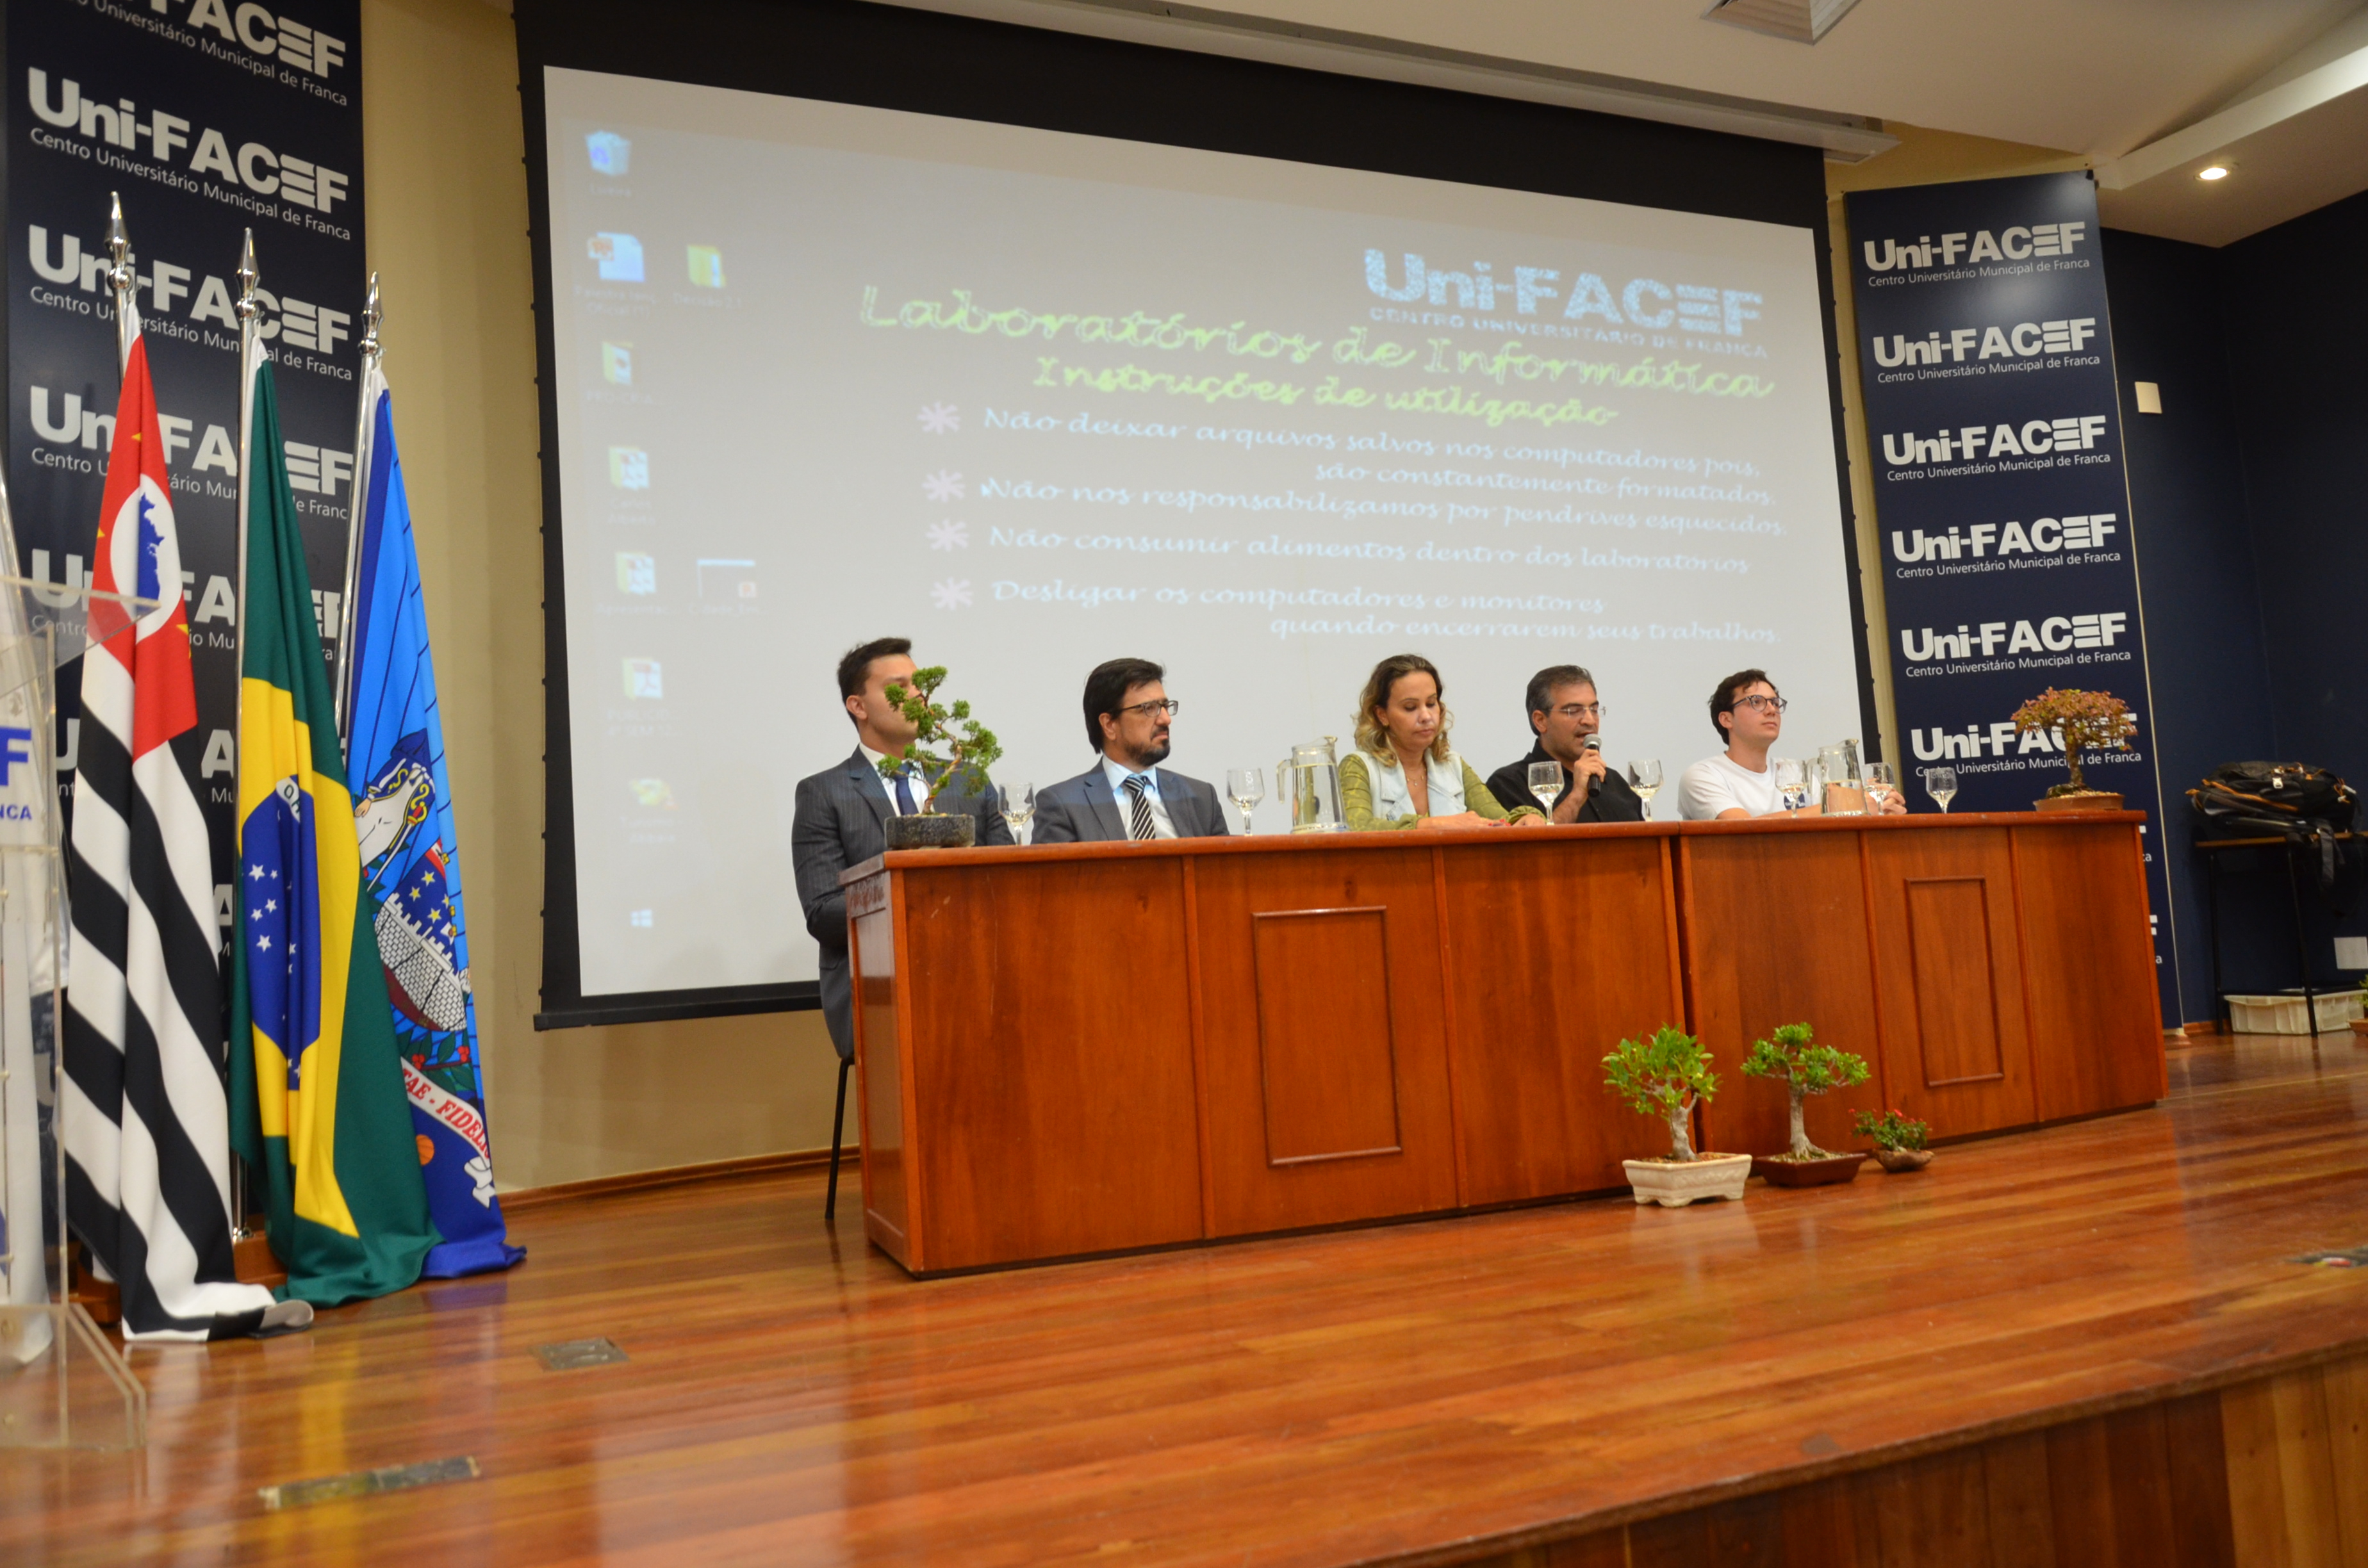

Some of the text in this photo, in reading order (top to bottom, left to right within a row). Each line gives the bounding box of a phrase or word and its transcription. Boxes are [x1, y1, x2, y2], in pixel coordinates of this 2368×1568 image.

[151, 0, 346, 78] ACEF
[201, 38, 274, 78] Municipal
[280, 70, 298, 87] de
[302, 78, 347, 106] Franca
[28, 67, 349, 213] Uni-FACEF
[31, 127, 350, 241] Centro Universitário Municipal de Franca
[1864, 222, 2085, 272] Uni-FACEF
[1363, 249, 1763, 337] Uni-FACEF
[1868, 259, 2090, 287] Centro Universitário Municipal de Franca
[30, 286, 90, 314] Centro
[204, 329, 278, 363] Munal
[284, 352, 302, 368] de
[307, 358, 352, 381] Franca
[860, 284, 1774, 396] Laboratórios de Informática
[1370, 307, 1465, 329] CENTRO
[1873, 318, 2095, 367] Uni-FACEF
[1315, 377, 1376, 409] de
[1877, 355, 2100, 383] Centro Universitário Municipal de Franca
[984, 407, 1062, 430] Não
[1068, 412, 1187, 437] deixar
[1196, 425, 1338, 449] arquivos
[1347, 432, 1439, 455] salvos
[1445, 442, 1493, 459] nos
[1504, 445, 1697, 473] computadores
[1883, 415, 2105, 465] Uni-FACEF
[31, 448, 92, 476] Centro
[309, 500, 347, 519] Franc
[1315, 462, 1371, 480] são
[1377, 466, 1613, 495] constantemente
[1887, 453, 2111, 482] Centro Universitário Municipal de Franca
[988, 477, 1064, 498] Não
[1073, 487, 1133, 505] nos
[1142, 488, 1439, 520] responsabilizamos
[1447, 503, 1495, 524] por
[1504, 505, 1638, 528] pendrives
[990, 526, 1067, 549] Não
[1074, 534, 1238, 555] consumir
[1247, 535, 1409, 560] alimentos
[1415, 541, 1520, 564] dentro
[1526, 546, 1575, 567] dos
[1893, 513, 2116, 562] Uni-FACEF
[1896, 552, 2121, 579] Centro Universitário Municipal de Franca
[992, 580, 1607, 615] Desligar os computadores e monitores
[1270, 615, 1399, 640] quando
[1406, 619, 1581, 639] encerrarem
[1588, 623, 1642, 641] seus
[1902, 612, 2126, 661] Uni-FACEF
[1905, 651, 2132, 678] Centro Universitário Municipal de Franca
[1955, 758, 2026, 774] Universitário
[2028, 754, 2084, 769] Municil
[2087, 753, 2102, 765] de
[2104, 752, 2142, 764] Franca
